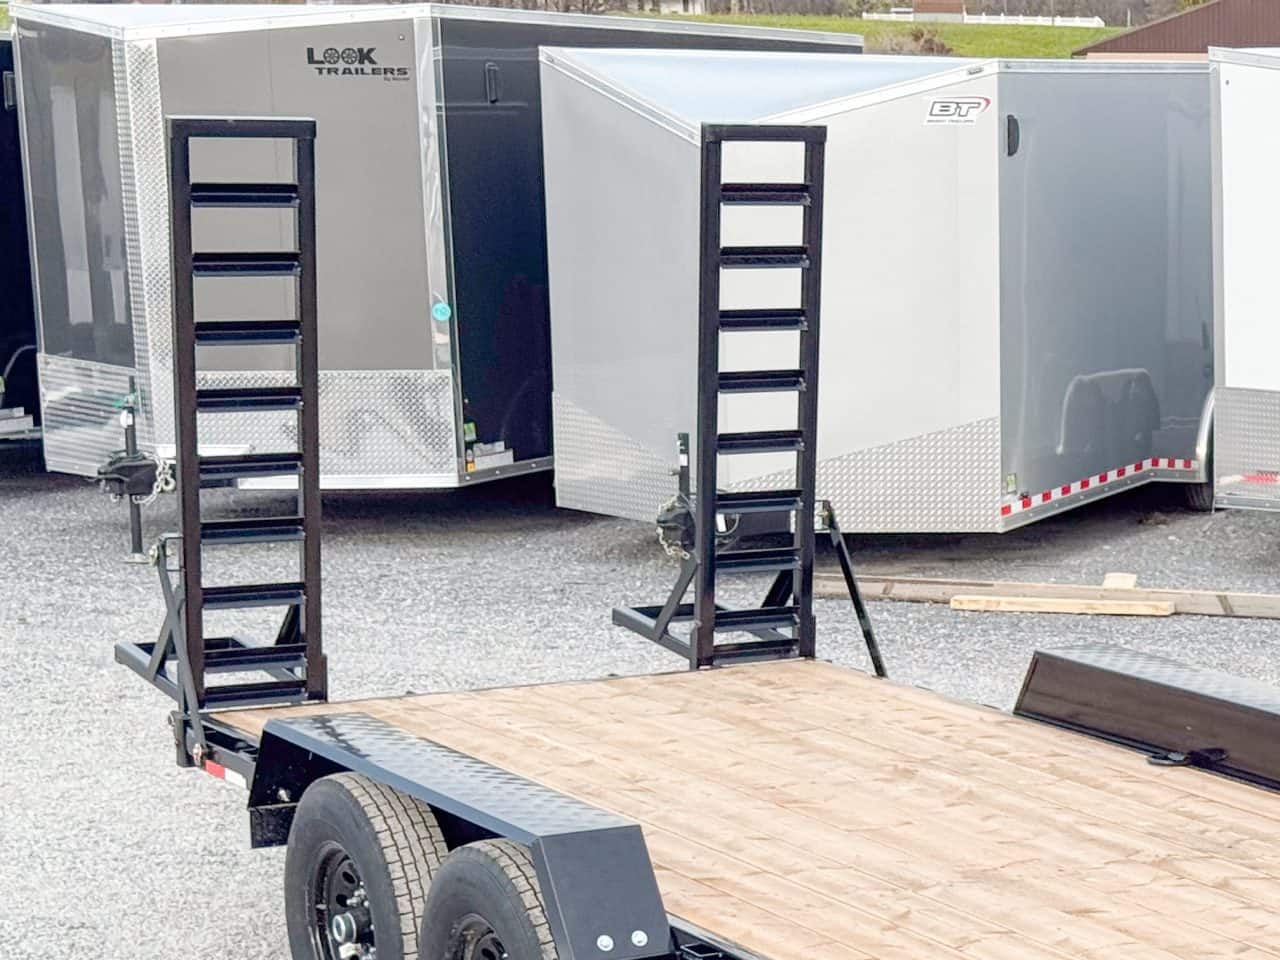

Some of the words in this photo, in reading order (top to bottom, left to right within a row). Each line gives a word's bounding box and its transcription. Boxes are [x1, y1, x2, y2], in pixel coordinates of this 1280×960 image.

[307, 47, 378, 65] LOOK
[314, 67, 409, 76] TRAILERS
[929, 101, 981, 117] BT
